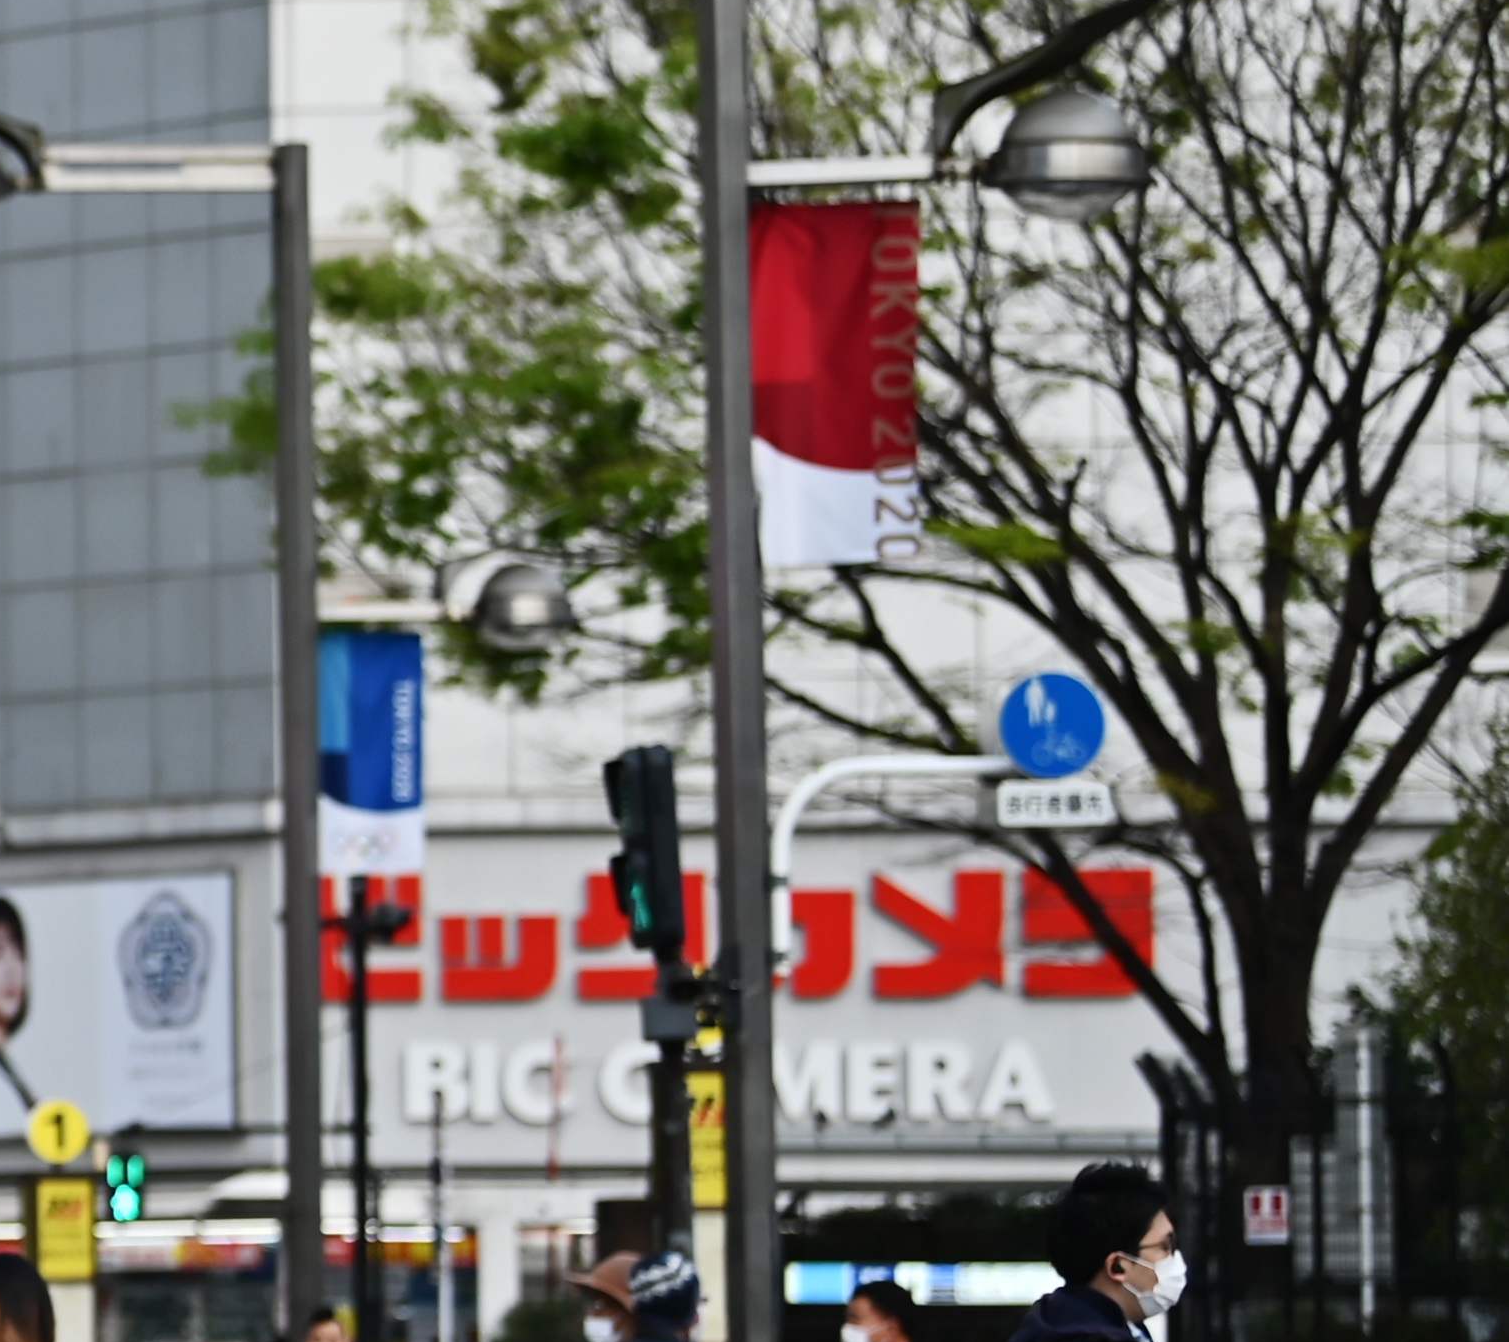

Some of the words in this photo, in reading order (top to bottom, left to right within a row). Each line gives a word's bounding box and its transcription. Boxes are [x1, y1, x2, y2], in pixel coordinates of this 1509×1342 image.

[869, 207, 919, 401] TOKYO
[872, 420, 924, 565] 2020
[51, 1114, 65, 1147] 1
[404, 1040, 572, 1126] BIC
[599, 1038, 1053, 1126] CMERA
